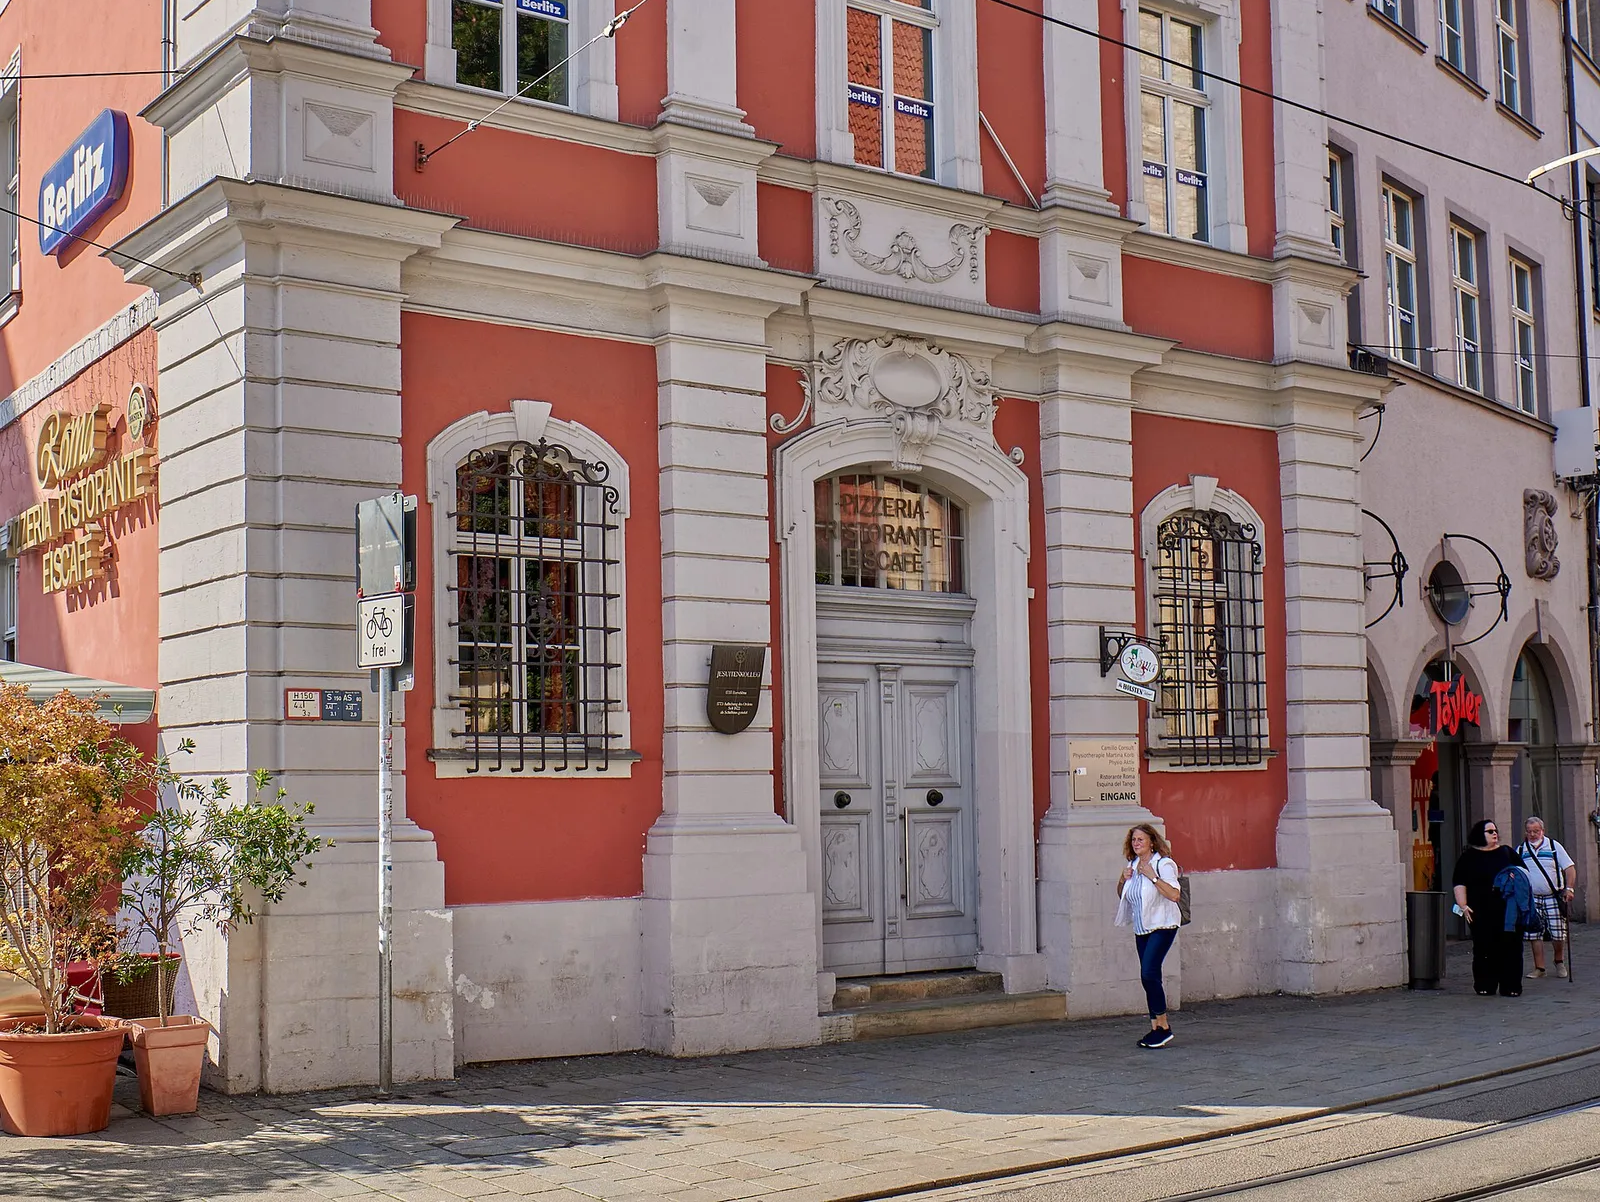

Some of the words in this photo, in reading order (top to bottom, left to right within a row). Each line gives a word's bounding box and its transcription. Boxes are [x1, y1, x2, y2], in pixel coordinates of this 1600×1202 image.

[897, 100, 929, 117] Berlitz
[1142, 164, 1163, 177] erlitz
[1178, 172, 1203, 187] Berlitz
[43, 142, 105, 241] Berlitz
[36, 402, 103, 490] Roma
[6, 498, 53, 556] PIZZERIA
[58, 447, 147, 531] RISTORANTE
[840, 492, 925, 520] PIZZERIA
[372, 642, 388, 658] frei
[1122, 648, 1157, 674] Roma
[1430, 673, 1483, 736] Tayler
[1122, 780, 1136, 788] Tango
[1100, 792, 1136, 801] EINGANG
